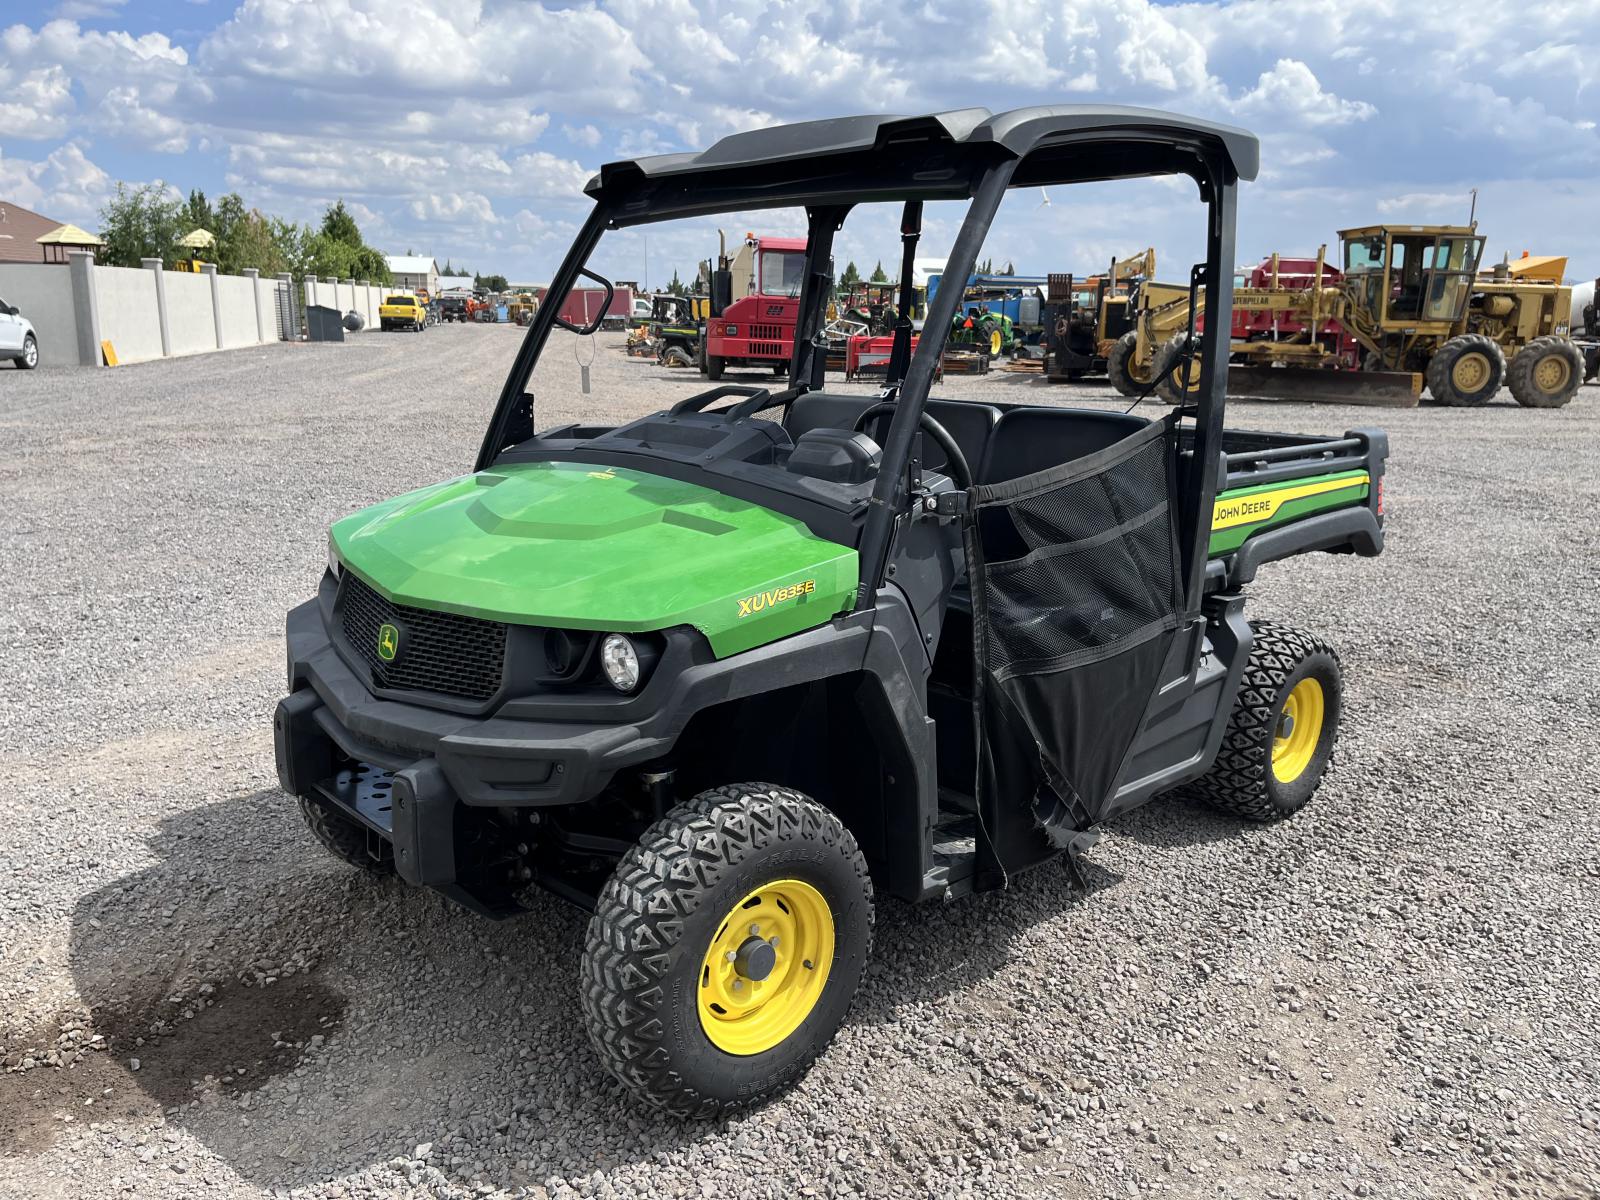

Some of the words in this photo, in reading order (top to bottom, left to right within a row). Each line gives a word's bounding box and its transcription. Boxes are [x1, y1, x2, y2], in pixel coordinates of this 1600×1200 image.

[1232, 297, 1269, 305] ATERPILLAR
[1215, 506, 1240, 521] JOHN
[1241, 500, 1271, 516] DEERE
[737, 579, 815, 617] XUV835E
